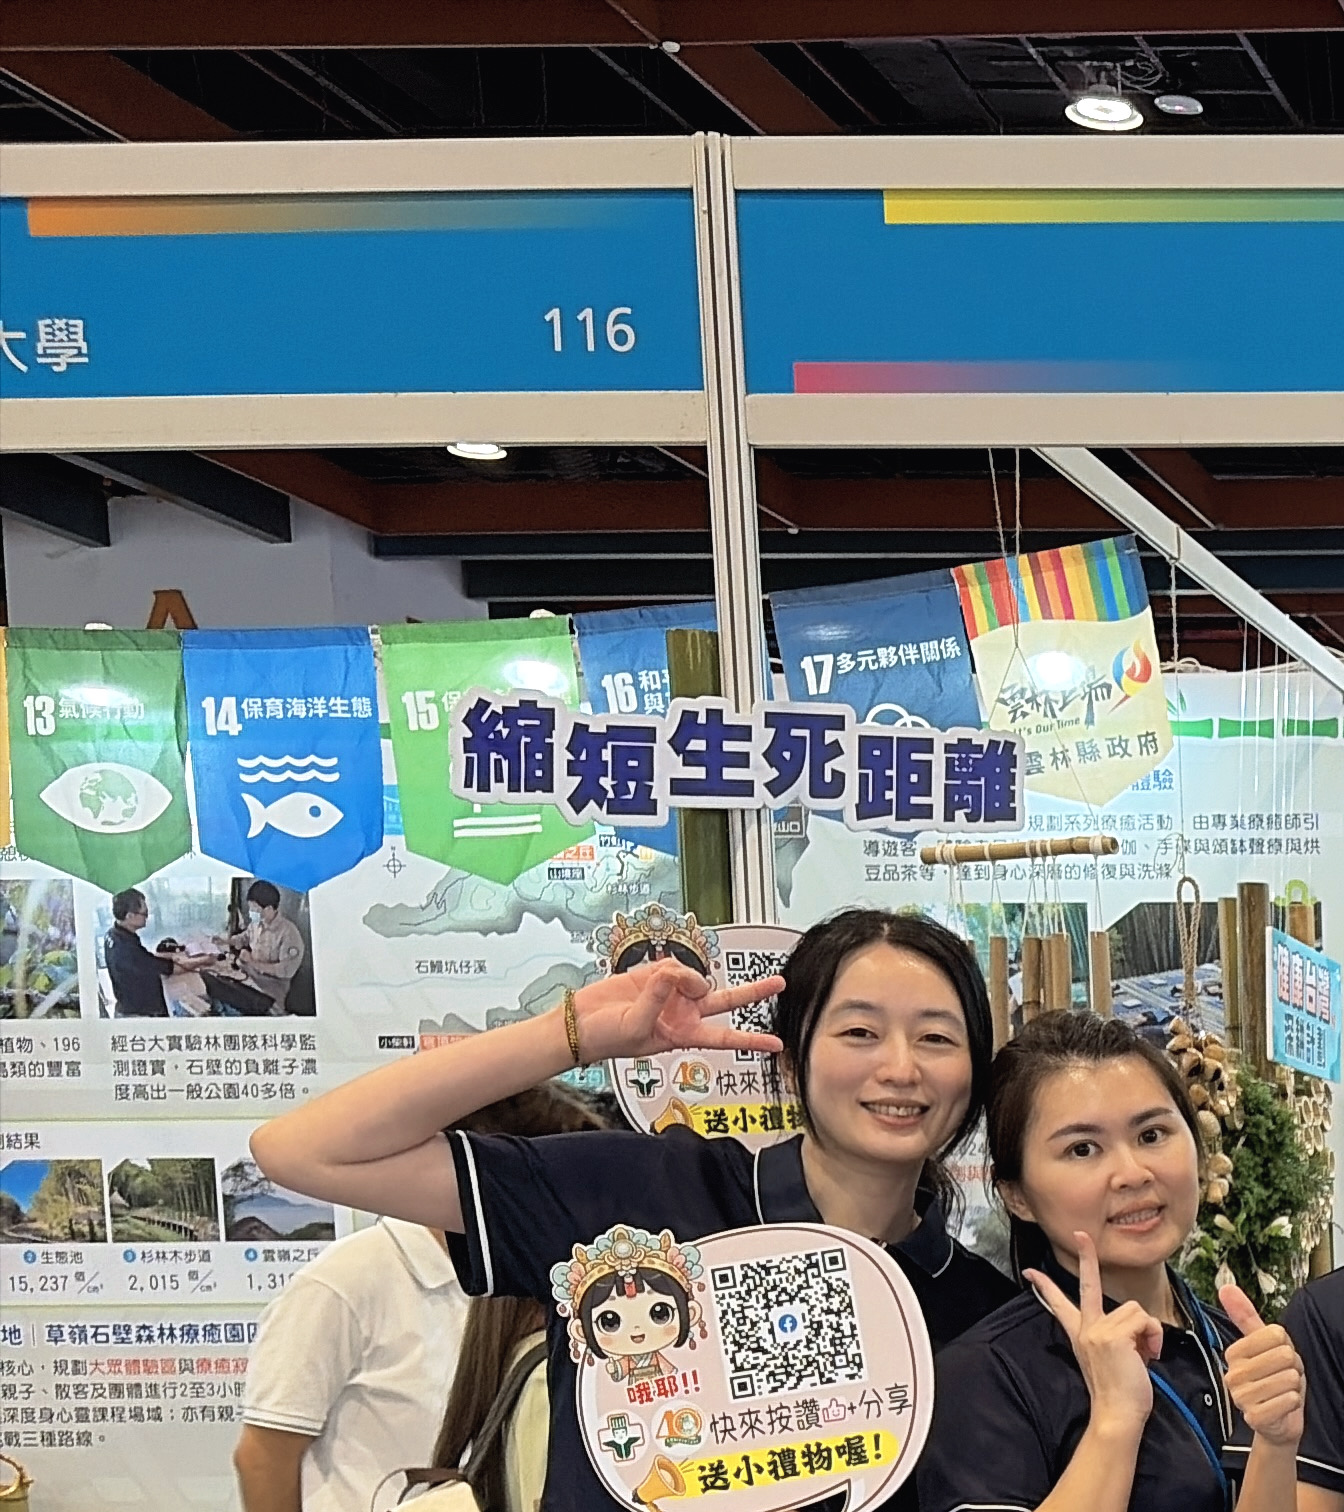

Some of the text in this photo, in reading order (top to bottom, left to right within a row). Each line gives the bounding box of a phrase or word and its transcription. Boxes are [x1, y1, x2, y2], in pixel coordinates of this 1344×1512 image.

[544, 306, 636, 353] 116
[801, 636, 962, 696] 17 多元夥伴關係
[401, 690, 440, 731] 15
[601, 672, 636, 714] 16
[24, 696, 55, 736] 13
[202, 696, 373, 736] 14 保育海洋生態
[462, 699, 1017, 823] 縮短生死距離
[9, 1274, 69, 1293] 15,237
[128, 1274, 179, 1292] 2,015
[0, 1430, 105, 1448] 戰三種路線。
[710, 1399, 823, 1445] 快來按讚
